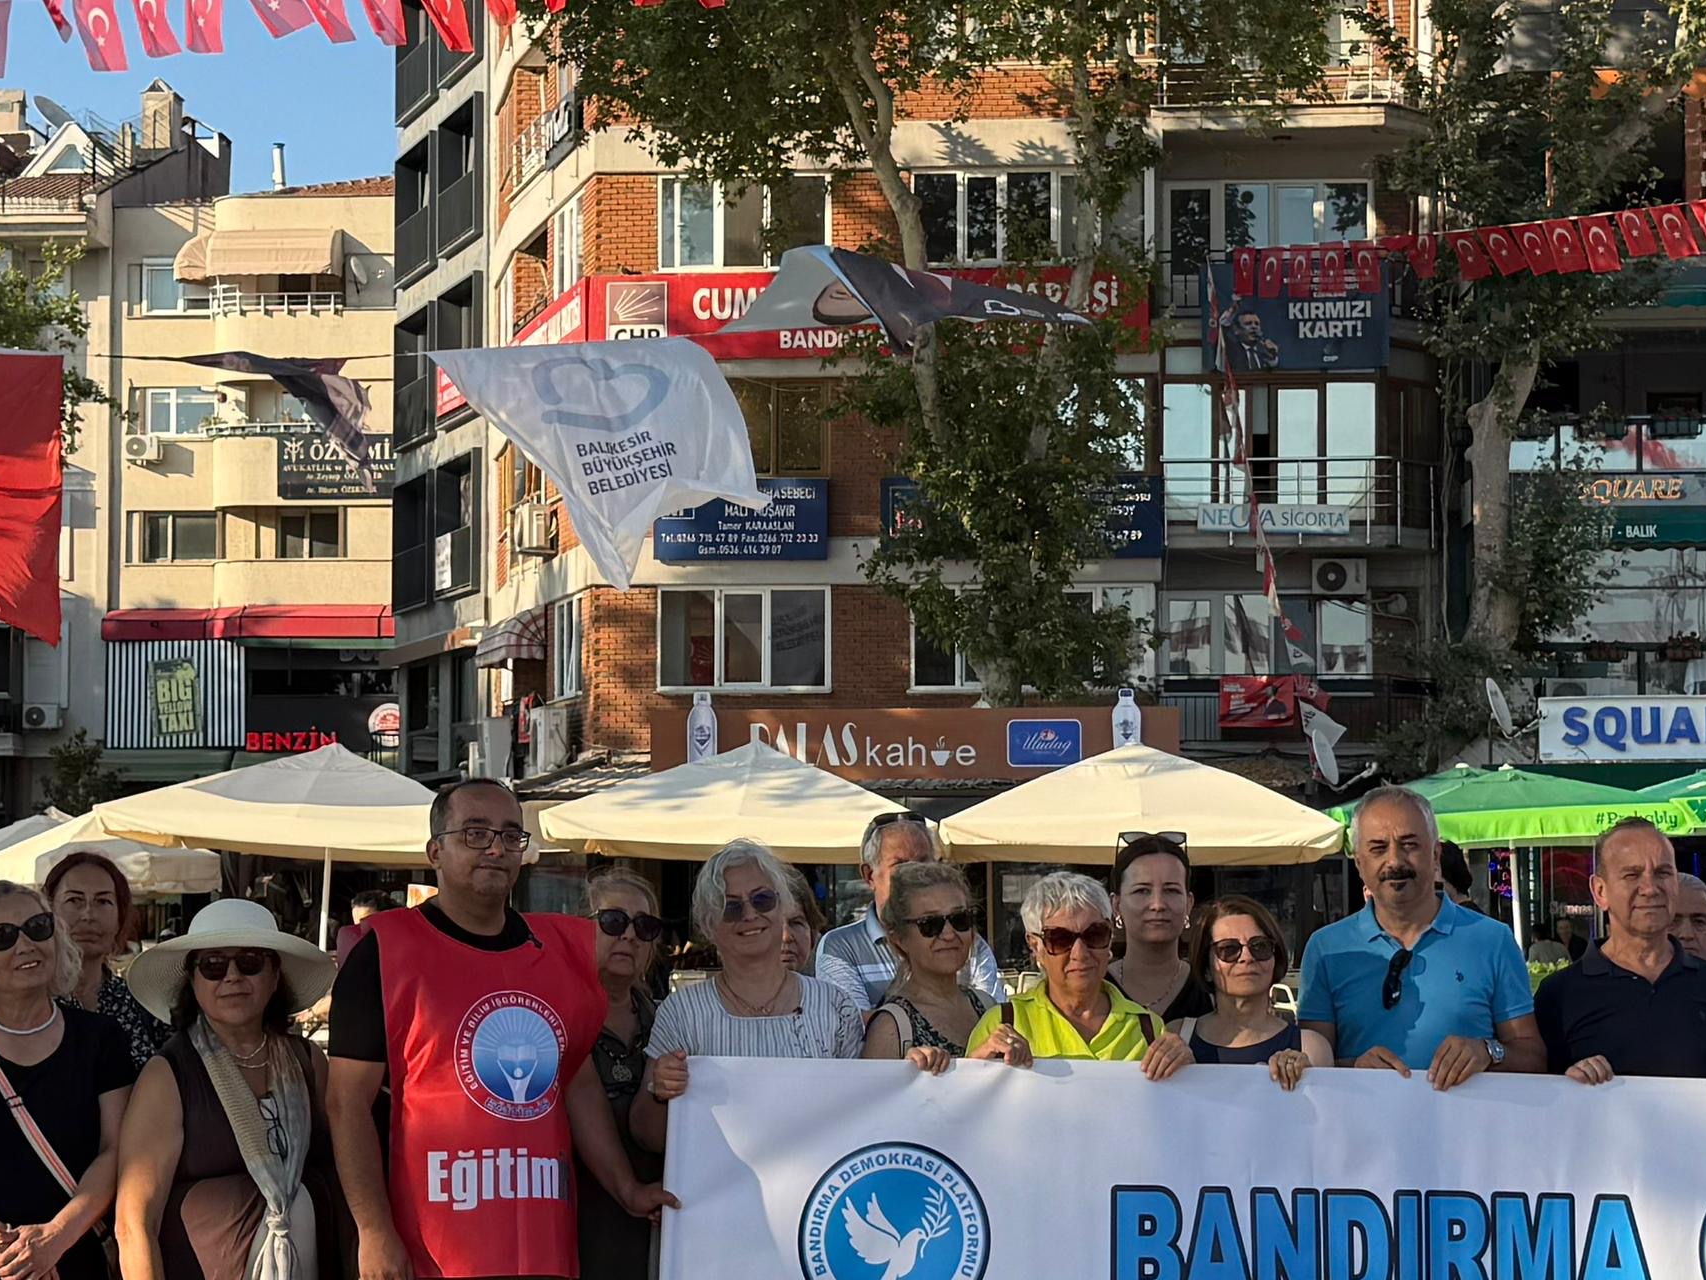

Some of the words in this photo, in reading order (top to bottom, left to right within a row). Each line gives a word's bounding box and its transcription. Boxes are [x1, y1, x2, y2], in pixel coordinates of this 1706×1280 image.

[1288, 300, 1372, 320] KIRMIZI
[1298, 320, 1363, 339] KART!
[581, 441, 678, 477] BÜYÜKŞEHİR
[588, 459, 673, 496] BELEDİYESİ
[1281, 507, 1346, 528] SİGORTA
[1625, 524, 1658, 539] BALIK
[156, 678, 194, 703] BIG
[158, 702, 194, 714] YELLOW
[159, 714, 194, 733] TAXI
[246, 725, 338, 752] BENZİN
[426, 1147, 560, 1212] Eğitim
[809, 1183, 841, 1277] BANDIRMA
[838, 1151, 944, 1185] DEMOKRASİ
[940, 1172, 980, 1278] PLATFORMU
